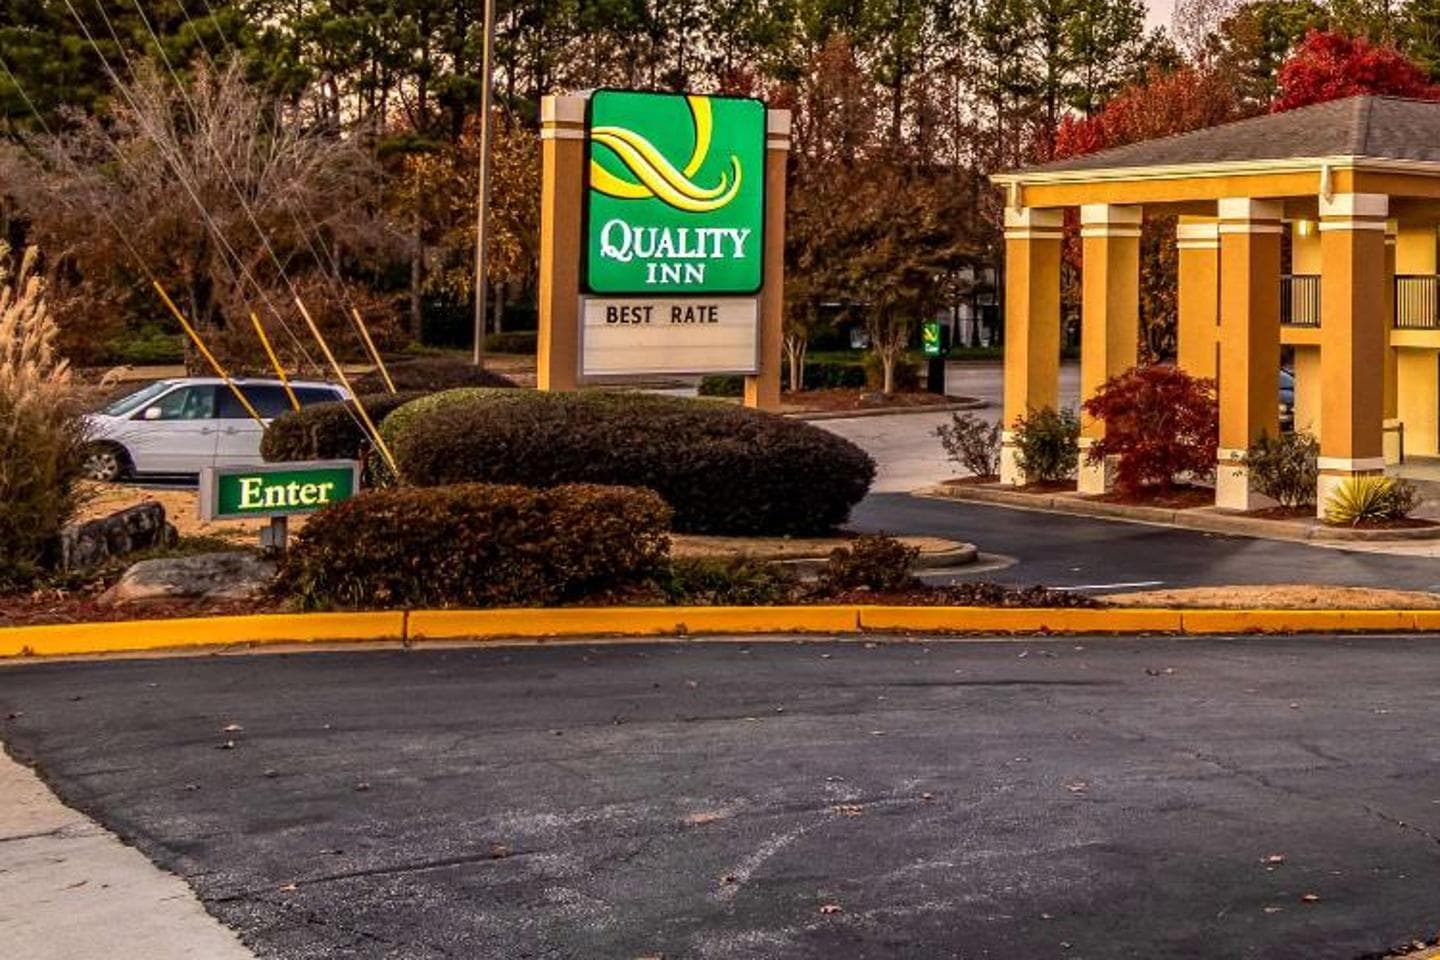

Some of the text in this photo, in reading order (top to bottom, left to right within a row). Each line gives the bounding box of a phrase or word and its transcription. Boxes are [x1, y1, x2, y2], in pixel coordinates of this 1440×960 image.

[600, 218, 751, 262] QUALITY
[646, 262, 706, 284] INN
[606, 305, 719, 324] BEST RATE
[238, 477, 334, 509] Enter
